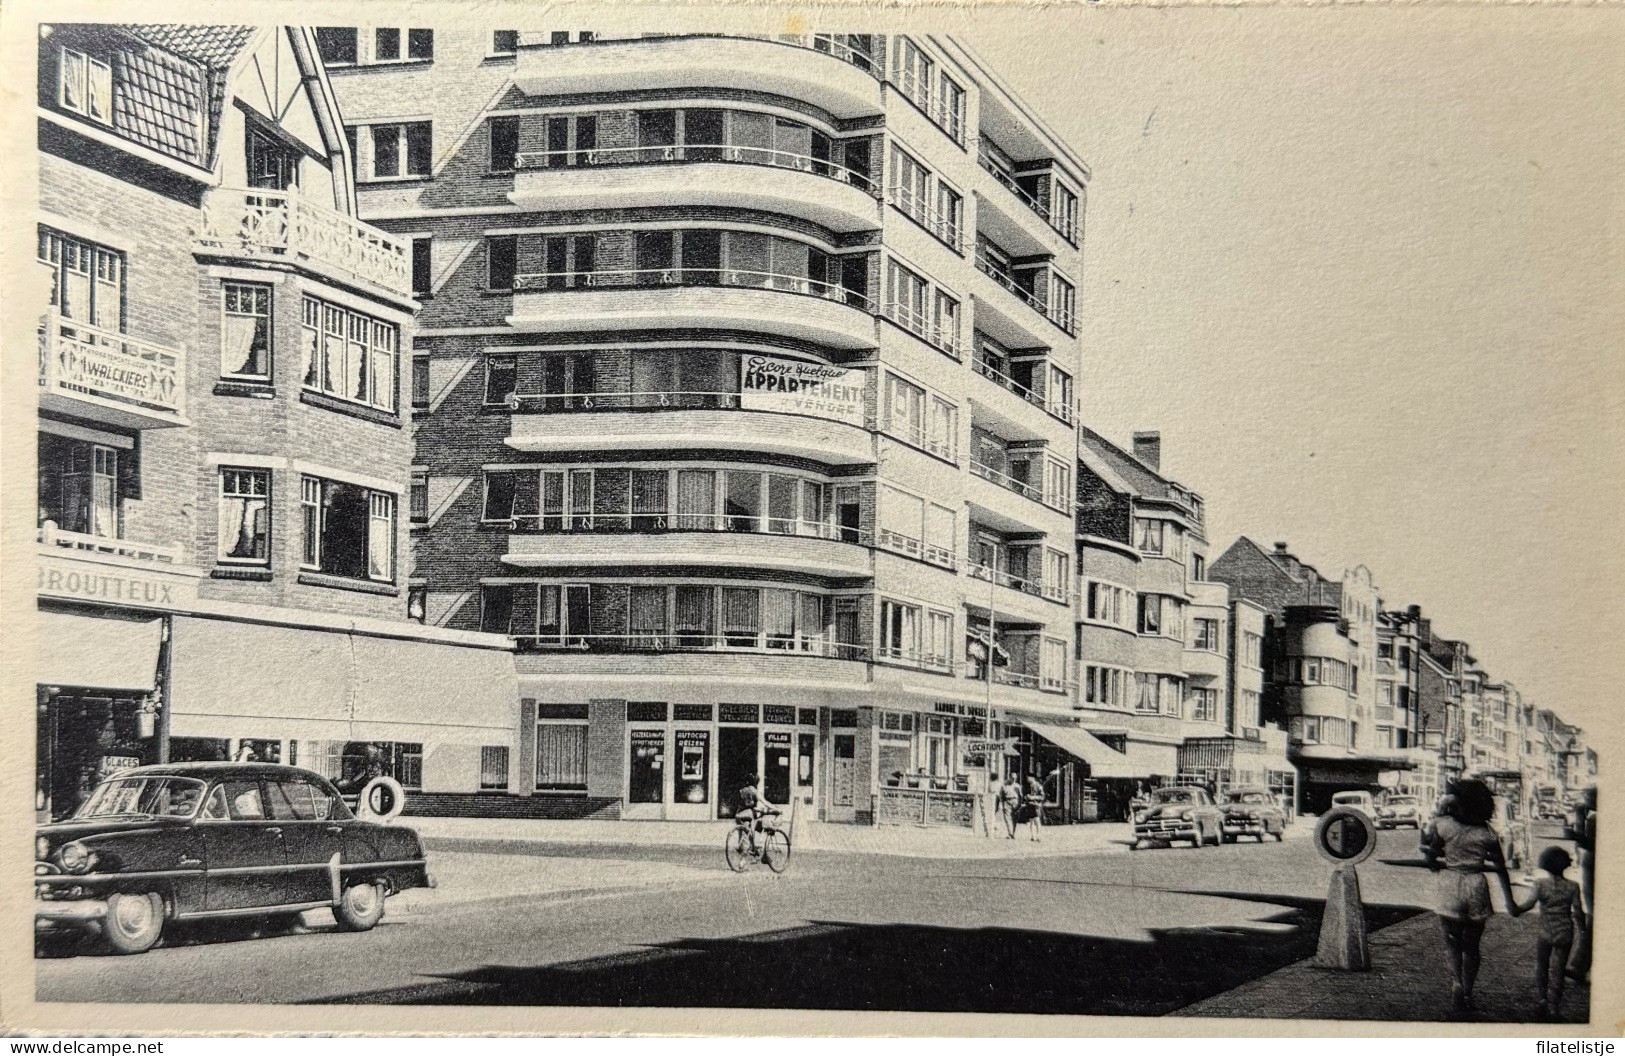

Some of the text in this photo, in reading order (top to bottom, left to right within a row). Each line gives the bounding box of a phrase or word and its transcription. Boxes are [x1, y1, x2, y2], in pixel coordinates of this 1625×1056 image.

[88, 361, 148, 388] WALCKIERS
[968, 743, 1006, 752] LOCATIONS
[106, 757, 138, 768] GLACES
